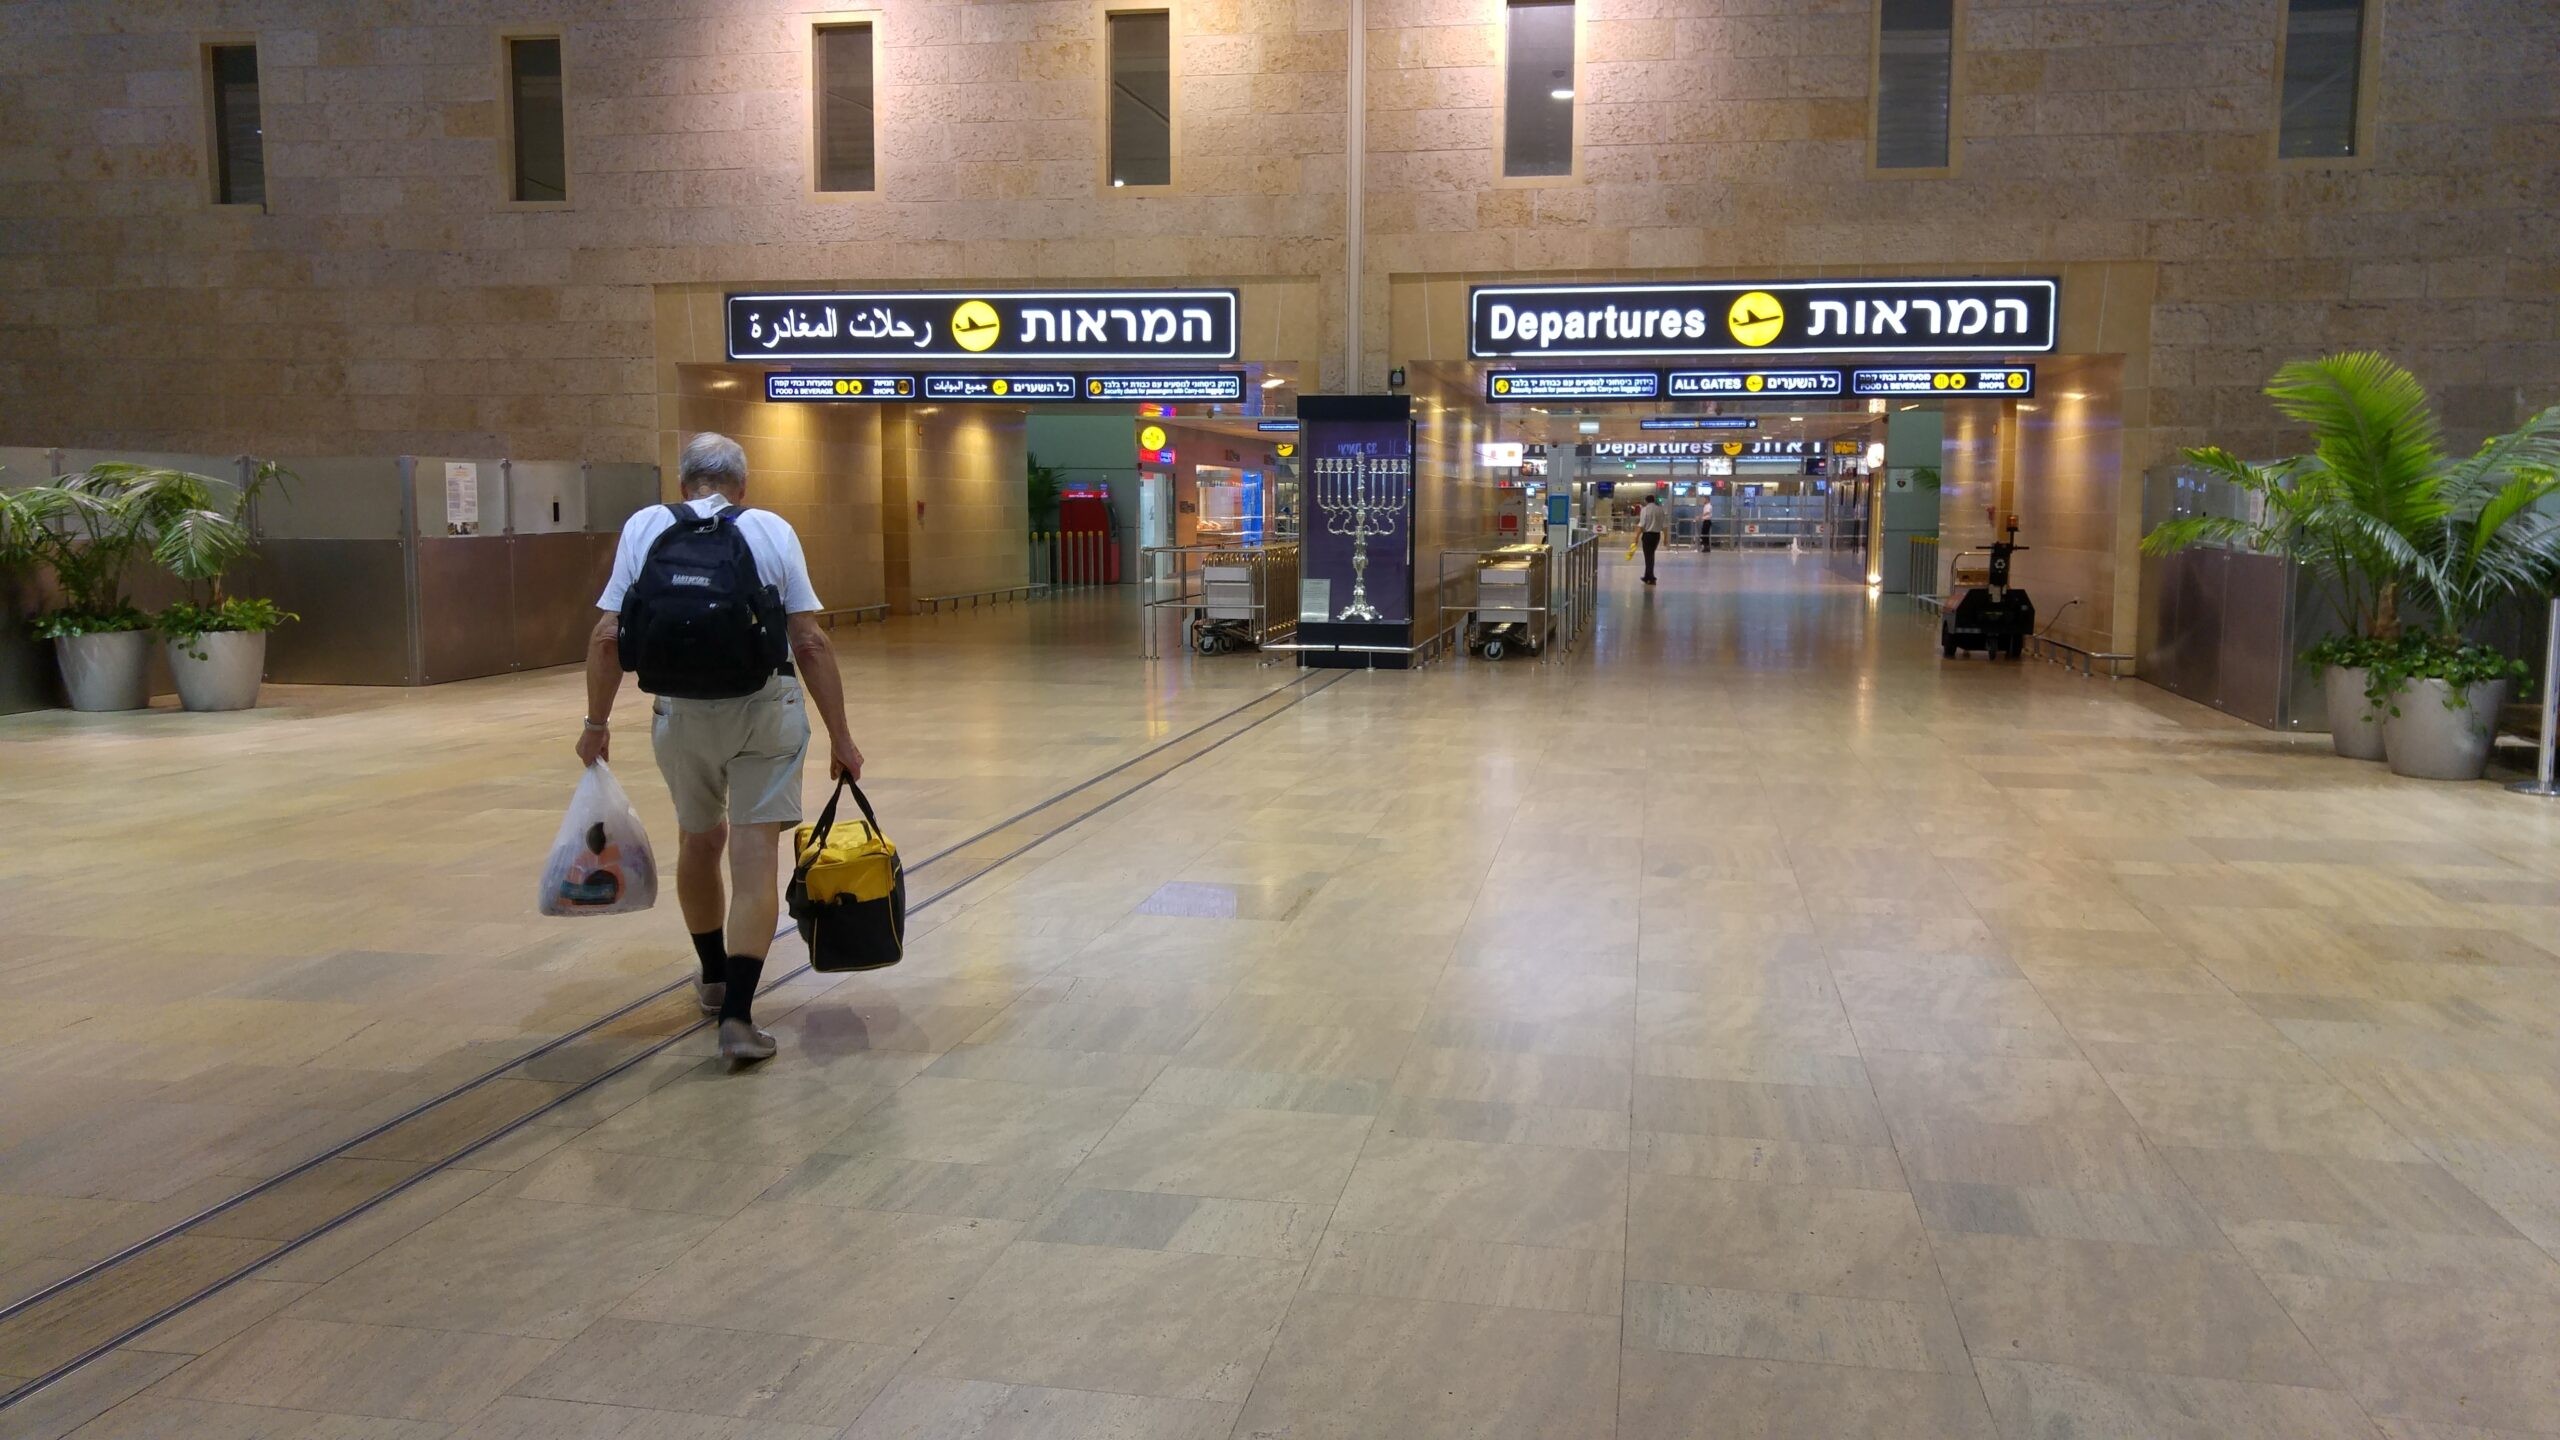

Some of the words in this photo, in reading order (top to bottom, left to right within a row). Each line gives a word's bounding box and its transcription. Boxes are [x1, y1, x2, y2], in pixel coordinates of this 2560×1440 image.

[1807, 295, 2028, 336] המראות
[749, 306, 838, 348] المغادرة
[850, 305, 932, 348] رحلات
[1020, 308, 1212, 343] המראות
[1490, 304, 1706, 348] Departures
[964, 382, 988, 394] جميع
[1013, 383, 1054, 394] השערים
[1056, 381, 1070, 392] כל
[1674, 379, 1698, 390] ALL
[1701, 378, 1742, 390] GATES
[1767, 378, 1817, 390] השערים
[1820, 375, 1836, 388] כל
[1595, 442, 1713, 458] Departures
